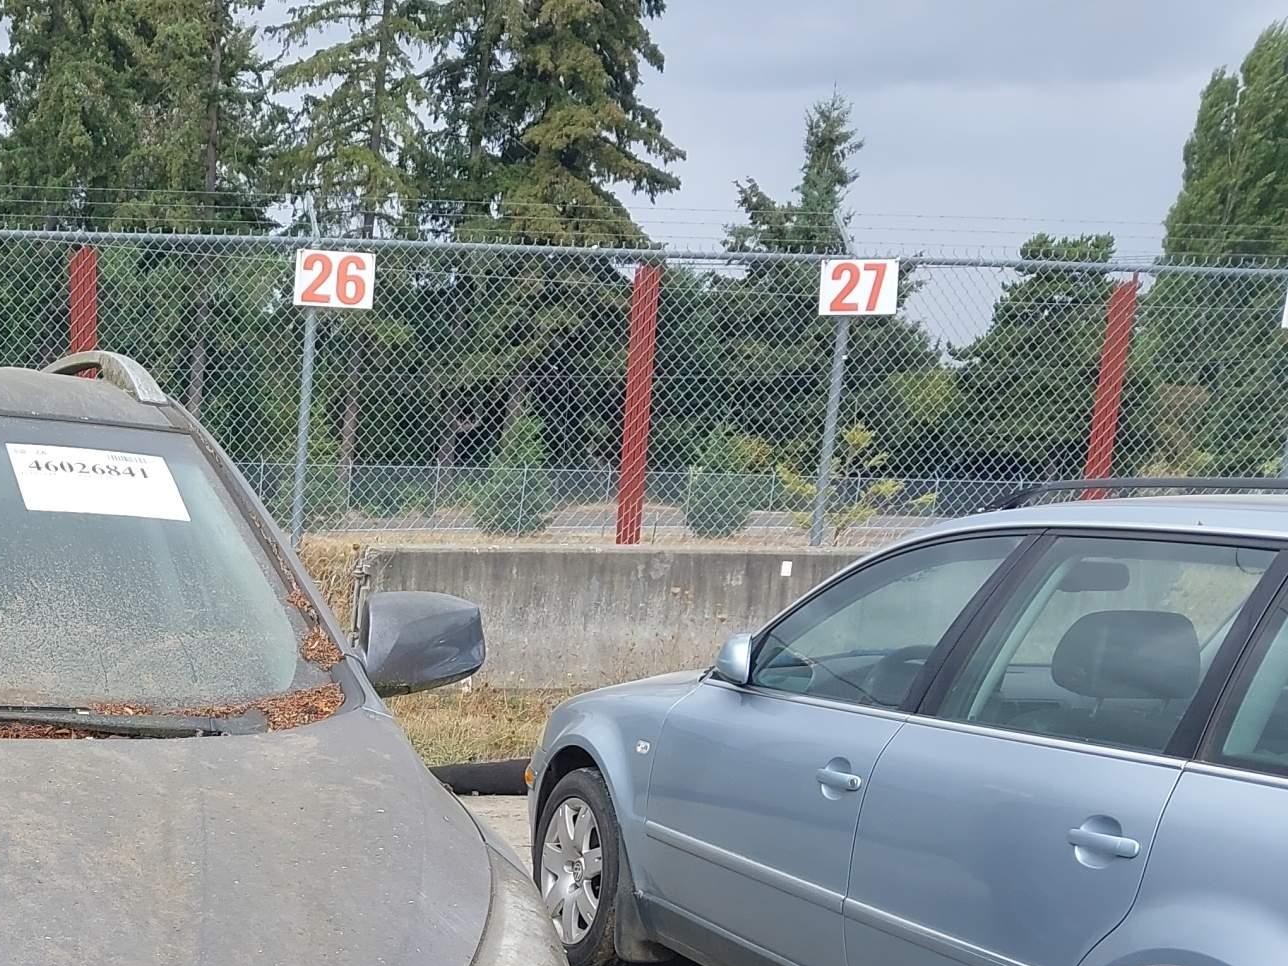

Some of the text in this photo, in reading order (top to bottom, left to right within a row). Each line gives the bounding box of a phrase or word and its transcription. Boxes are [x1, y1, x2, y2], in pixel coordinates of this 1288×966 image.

[300, 253, 366, 306] 26
[829, 262, 887, 313] 27
[26, 458, 150, 480] 46026841
